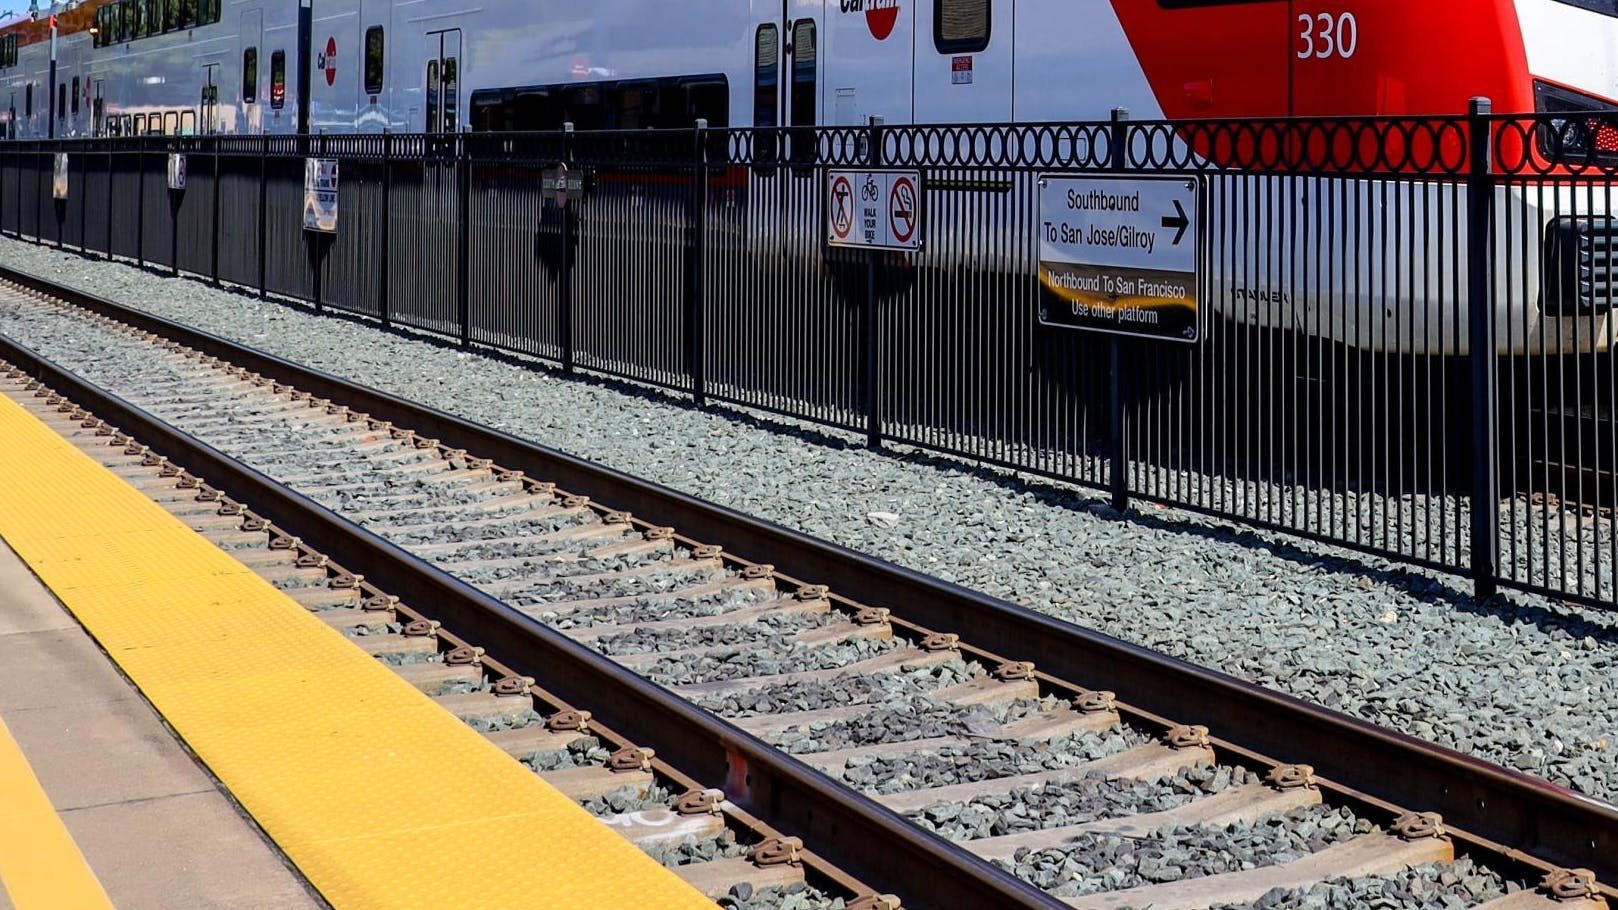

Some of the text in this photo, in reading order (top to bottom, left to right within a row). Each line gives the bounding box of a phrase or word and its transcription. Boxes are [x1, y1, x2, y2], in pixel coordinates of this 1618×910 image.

[1297, 12, 1357, 59] 330
[1067, 188, 1139, 211] Southbound
[864, 208, 876, 217] WALK
[864, 219, 876, 228] YOUR
[865, 230, 875, 240] BIKE
[1044, 221, 1155, 254] To San Jose/Gilroy
[1048, 270, 1186, 299] Northbound To San Francisco
[1072, 298, 1158, 324] Use other platform
